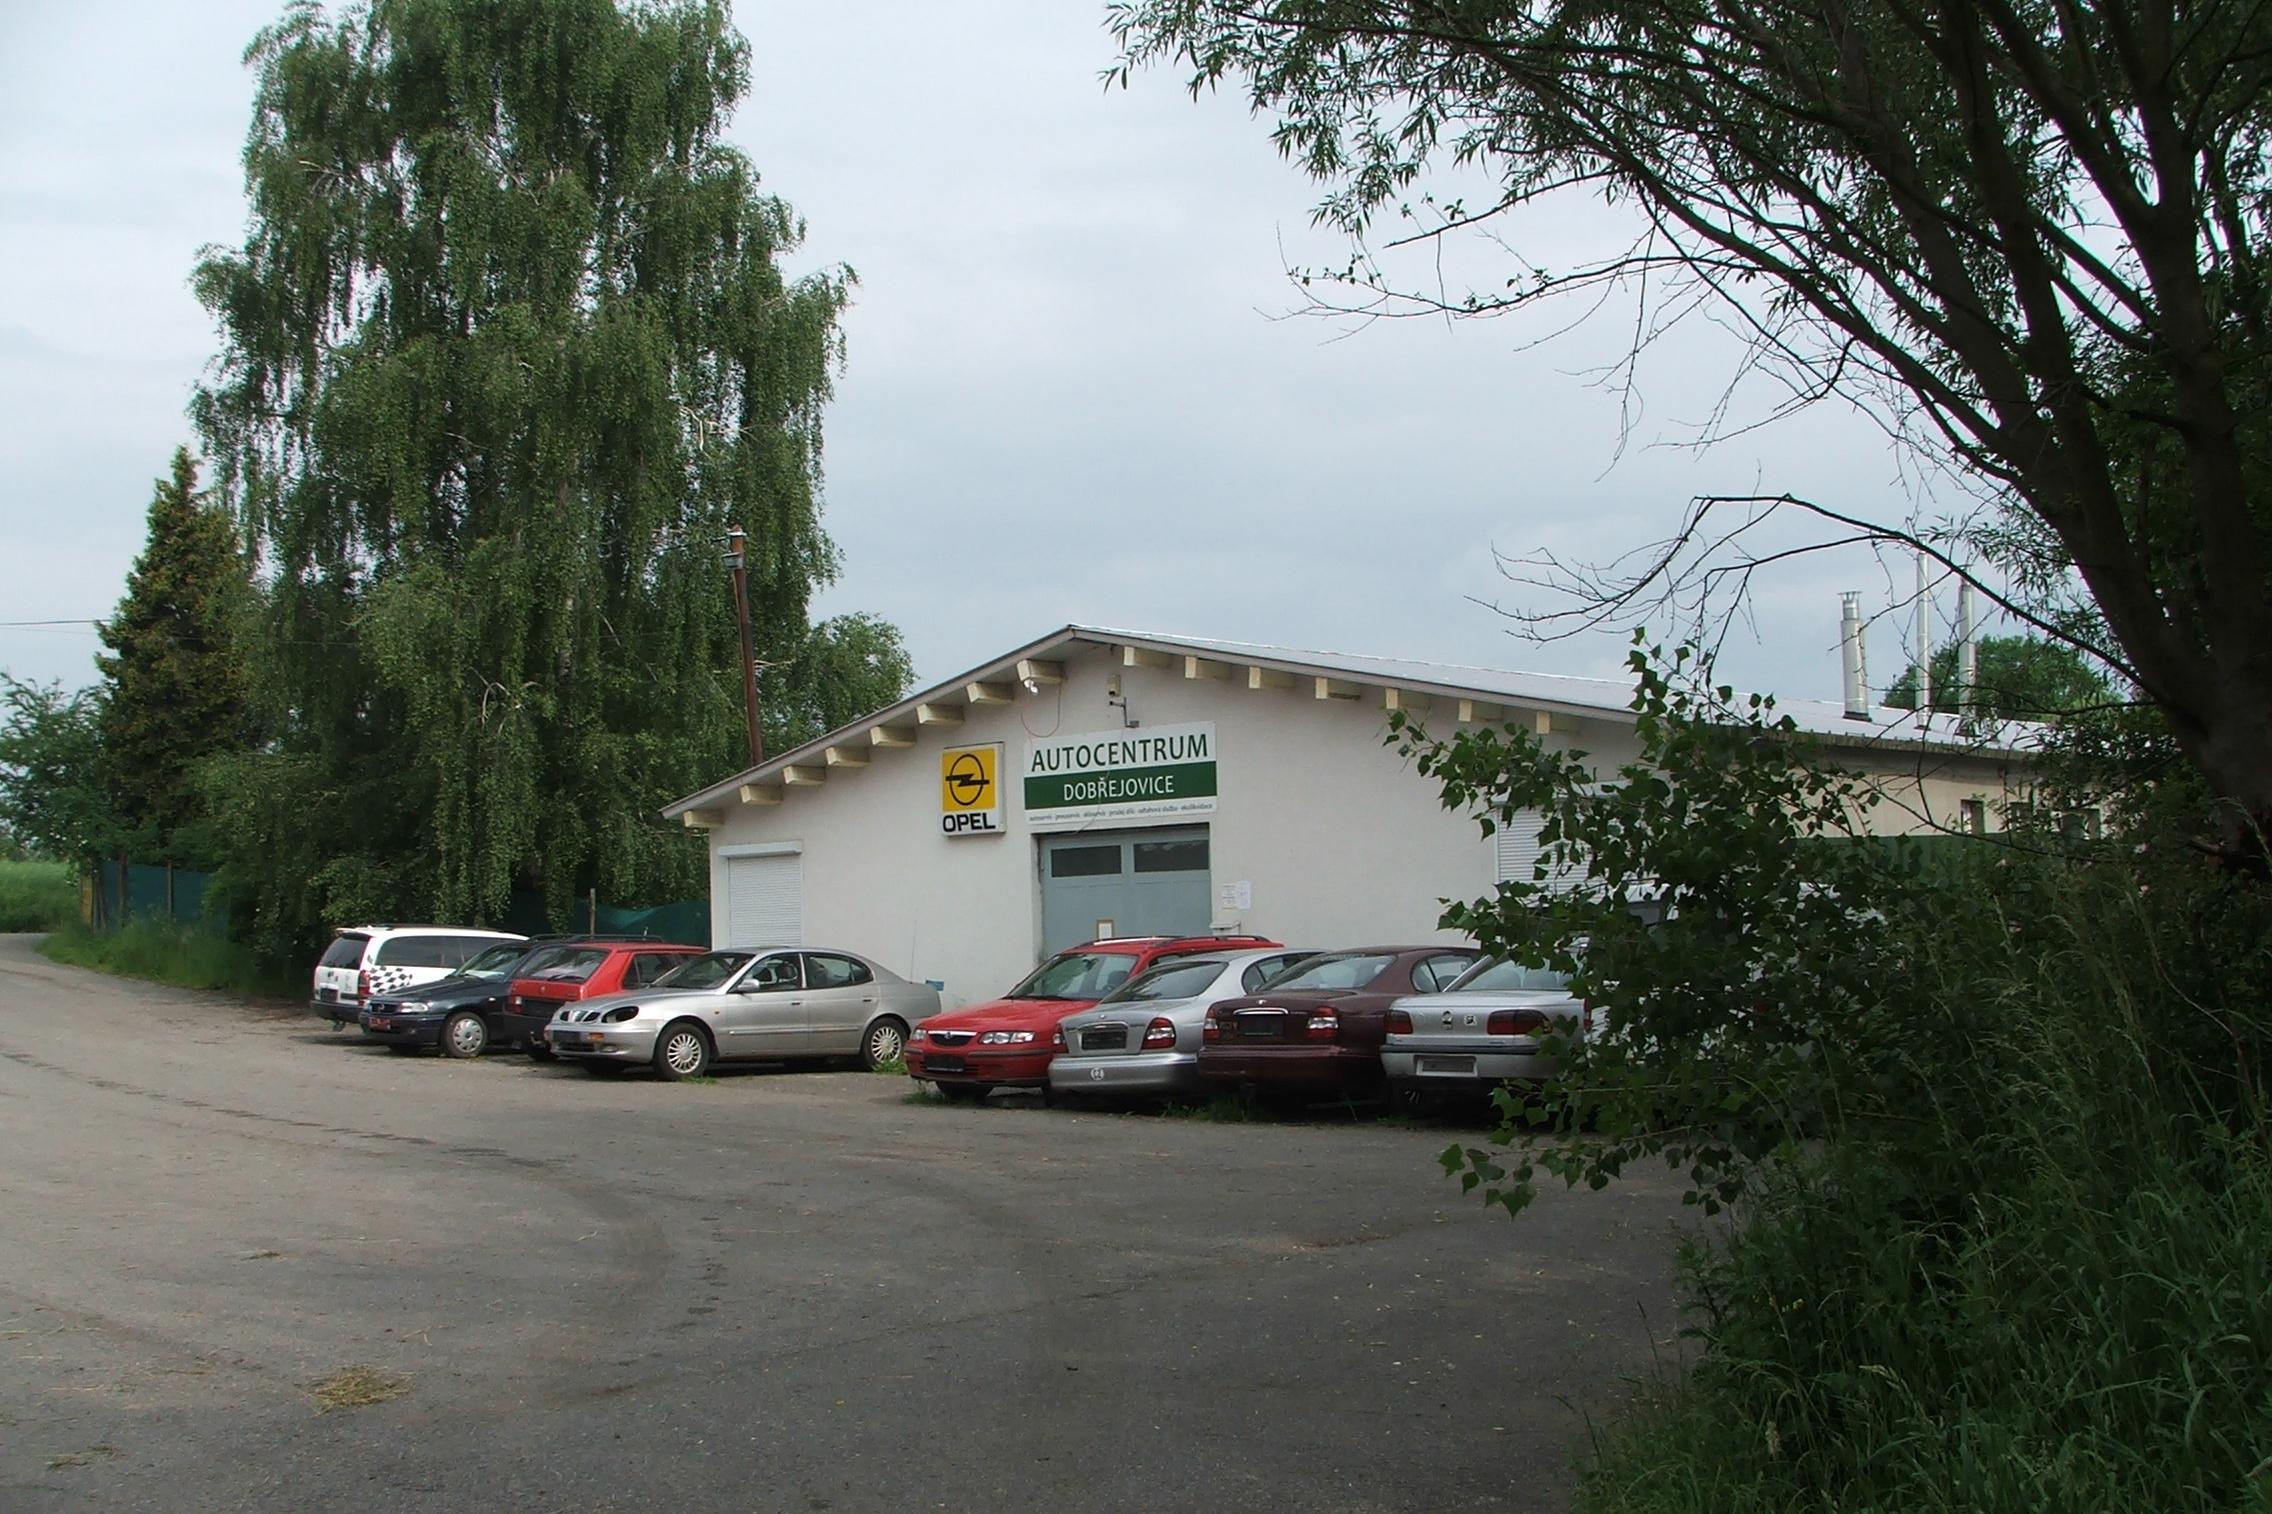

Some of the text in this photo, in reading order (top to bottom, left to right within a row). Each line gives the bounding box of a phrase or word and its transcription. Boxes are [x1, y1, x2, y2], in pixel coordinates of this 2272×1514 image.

[1031, 733, 1208, 772] AUTOCENTRUM
[1064, 775, 1174, 801] DOBŘEJOVICE
[943, 813, 996, 832] OPEL
